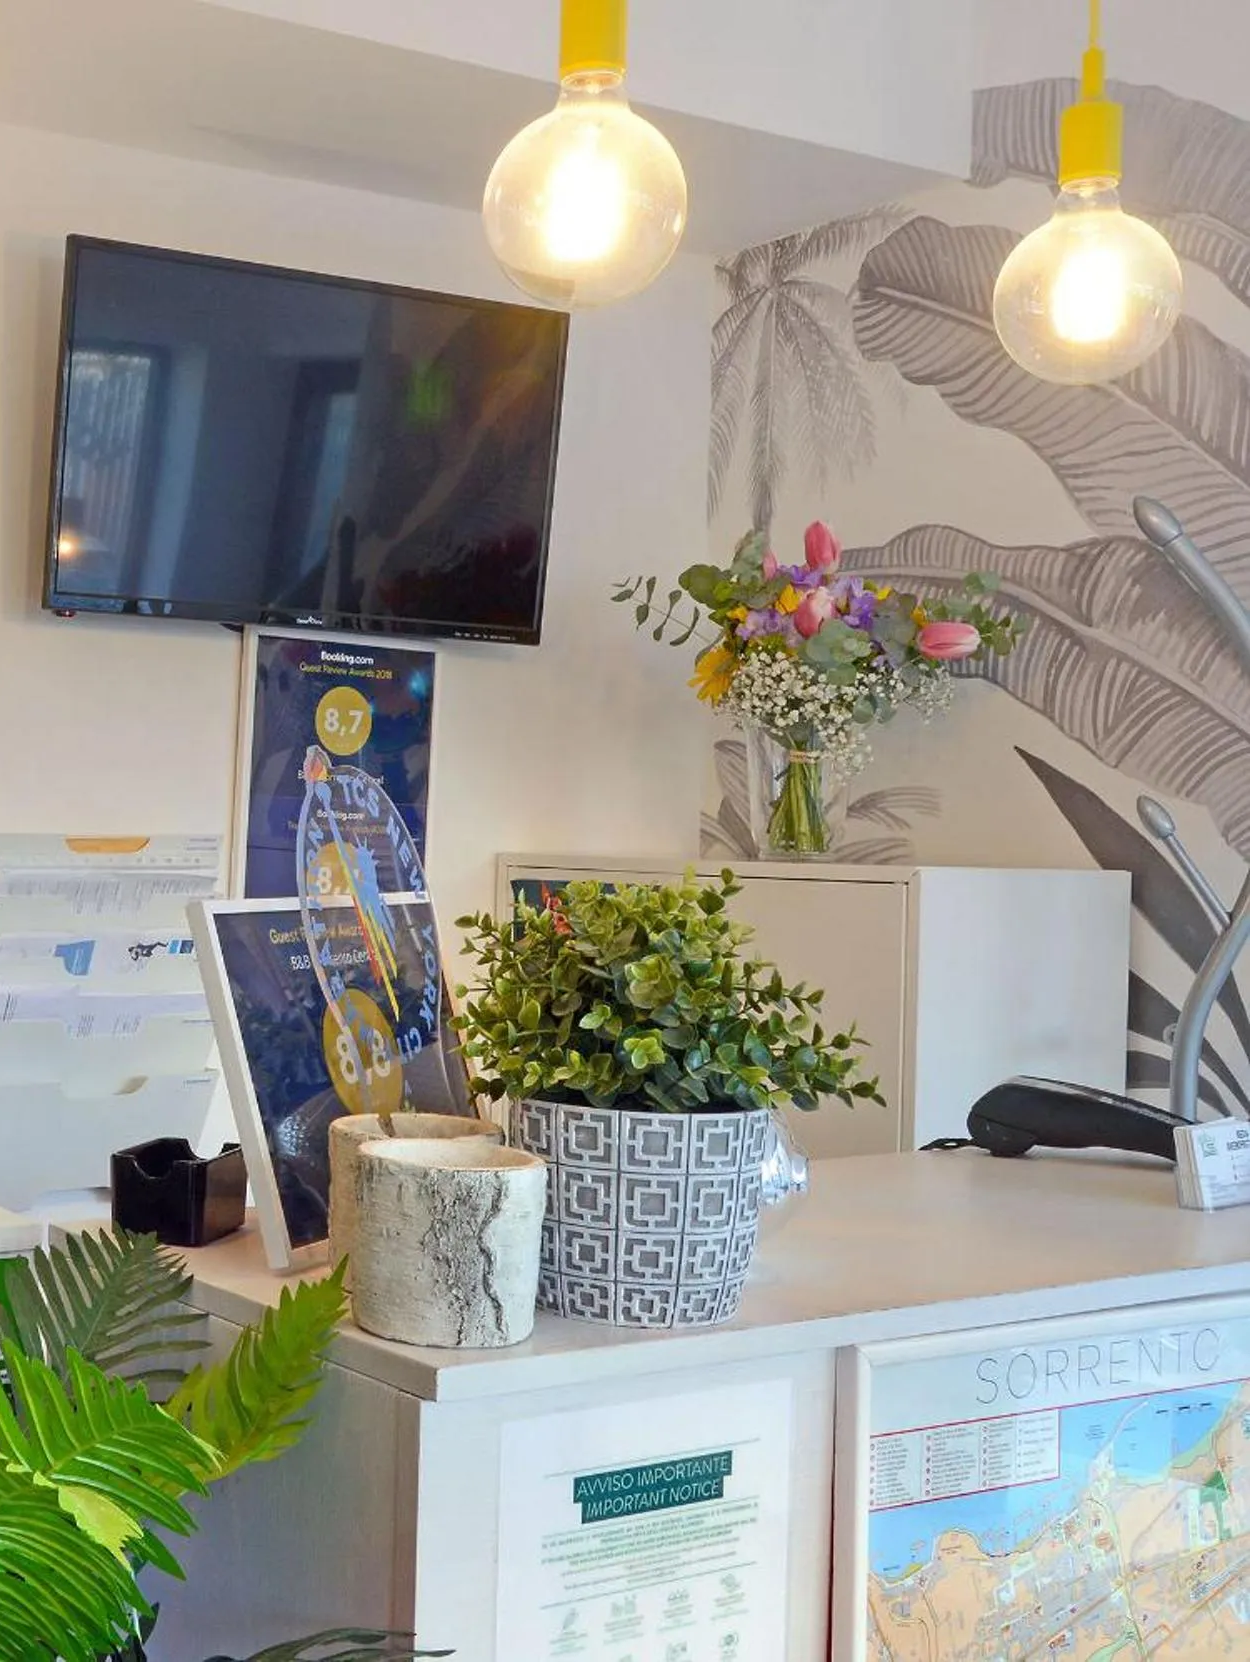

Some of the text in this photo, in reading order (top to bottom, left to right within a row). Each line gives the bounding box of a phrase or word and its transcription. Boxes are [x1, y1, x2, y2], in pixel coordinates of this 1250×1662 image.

[321, 651, 374, 666] Booking.com
[324, 708, 364, 737] 8,7
[269, 928, 299, 945] Guest
[975, 1327, 1222, 1405] SORRENTO
[575, 1455, 730, 1499] AVVISO IMPORTANTE
[586, 1480, 720, 1518] IMPORTANT NOTICE
